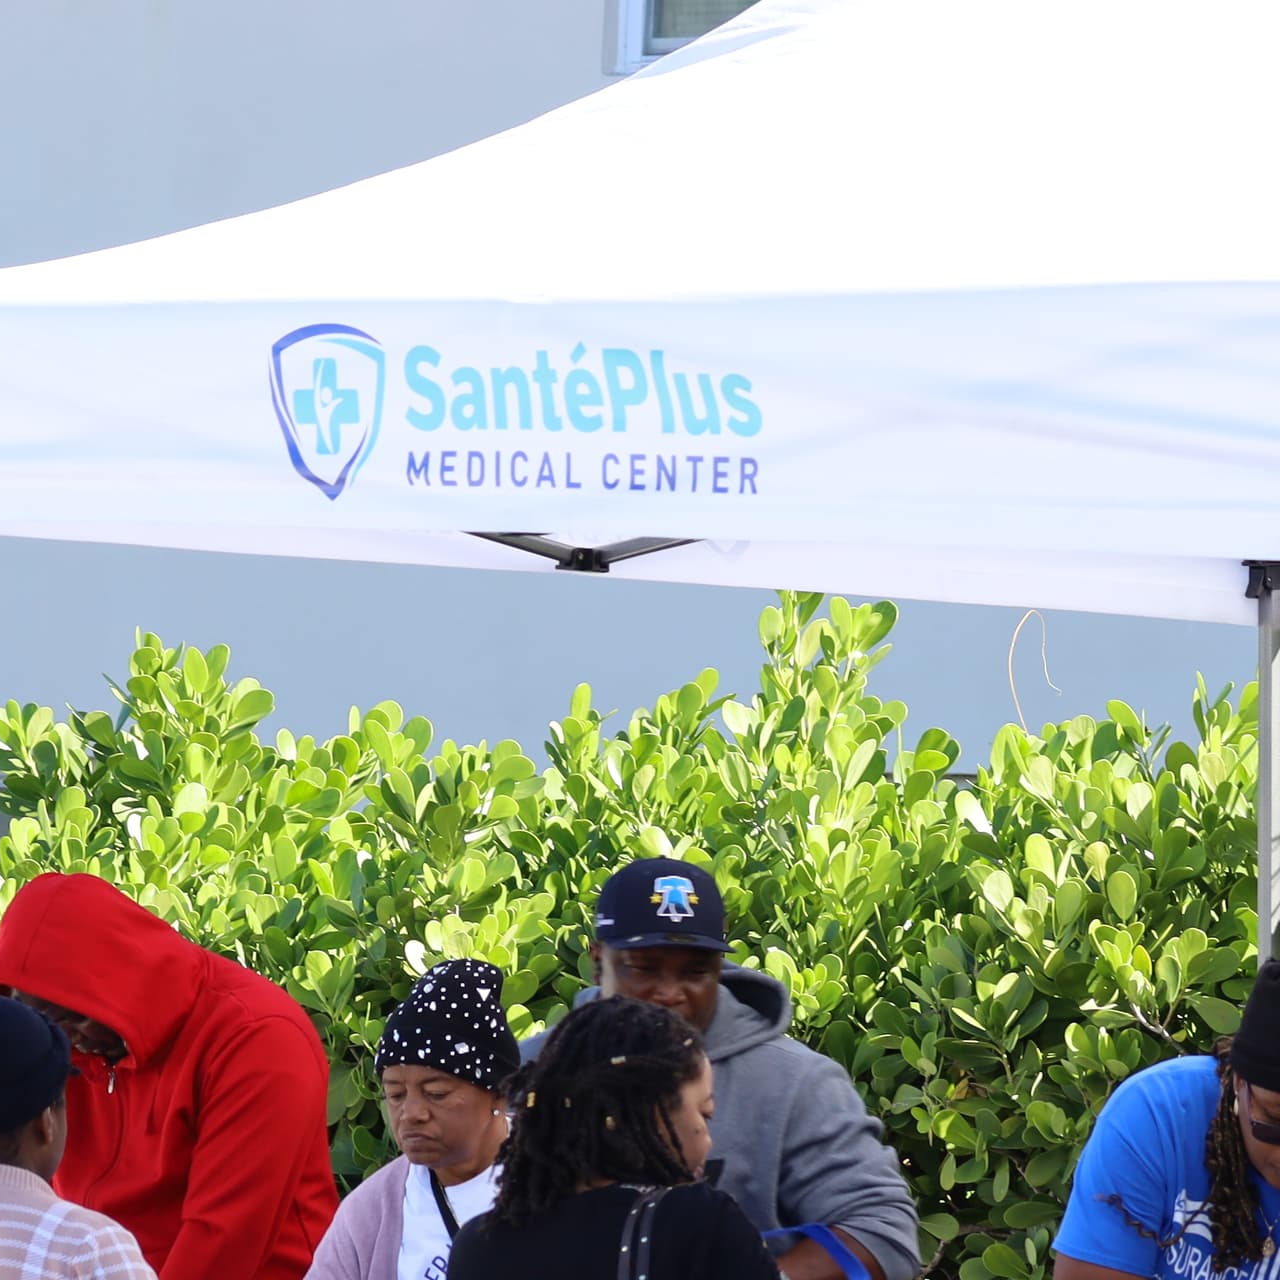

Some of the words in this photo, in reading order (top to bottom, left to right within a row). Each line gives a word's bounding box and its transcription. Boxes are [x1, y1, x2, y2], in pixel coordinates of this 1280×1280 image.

[404, 341, 762, 437] SantéPlus
[406, 450, 582, 489] MEDICAL
[601, 453, 759, 494] CENTER
